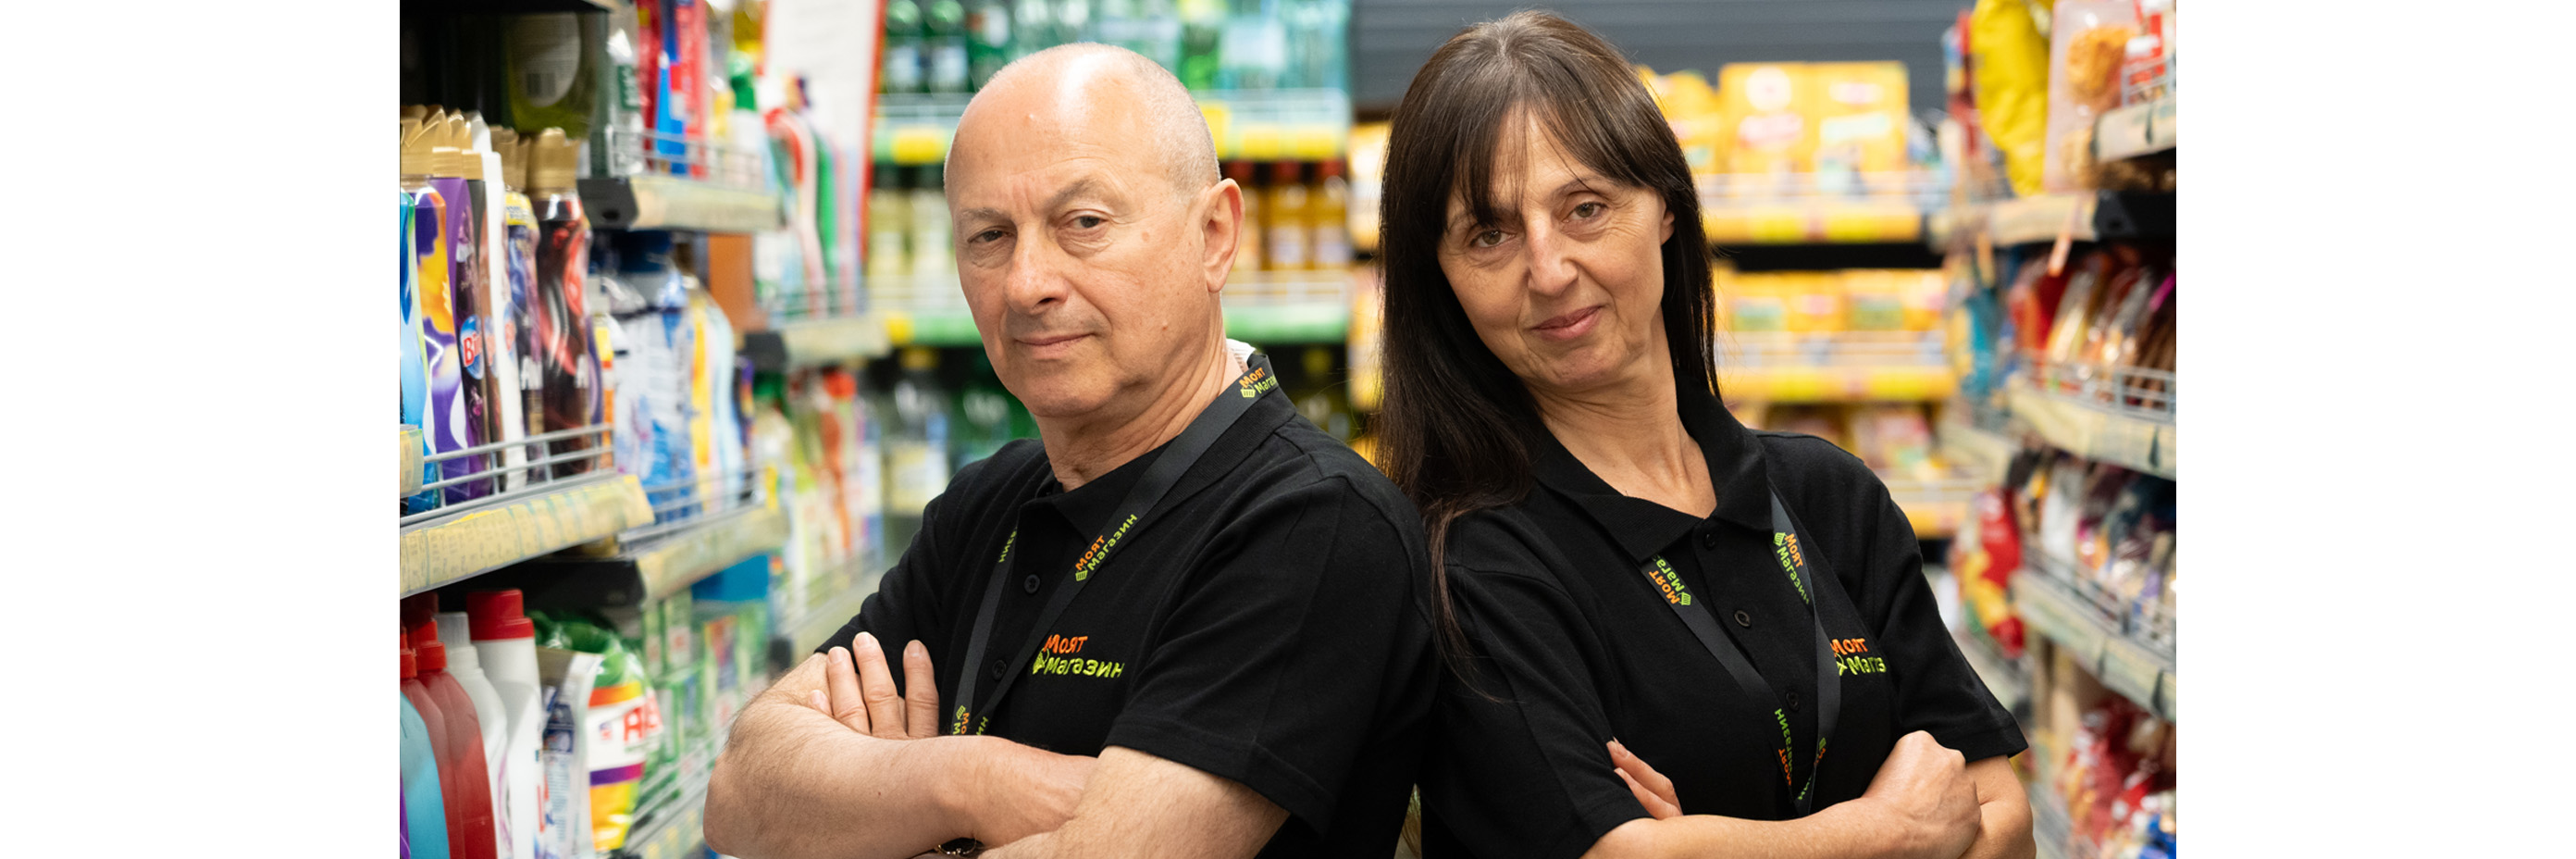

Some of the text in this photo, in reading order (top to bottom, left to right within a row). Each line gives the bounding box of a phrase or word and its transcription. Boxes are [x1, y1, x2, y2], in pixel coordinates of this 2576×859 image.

[1075, 535, 1105, 571] Моят
[1086, 514, 1138, 571] Магазин
[1784, 533, 1803, 567] Моят
[1648, 570, 1680, 604] Моят
[1655, 558, 1685, 592] Мага
[1043, 633, 1088, 654] Моят
[1043, 656, 1125, 678] Магазин
